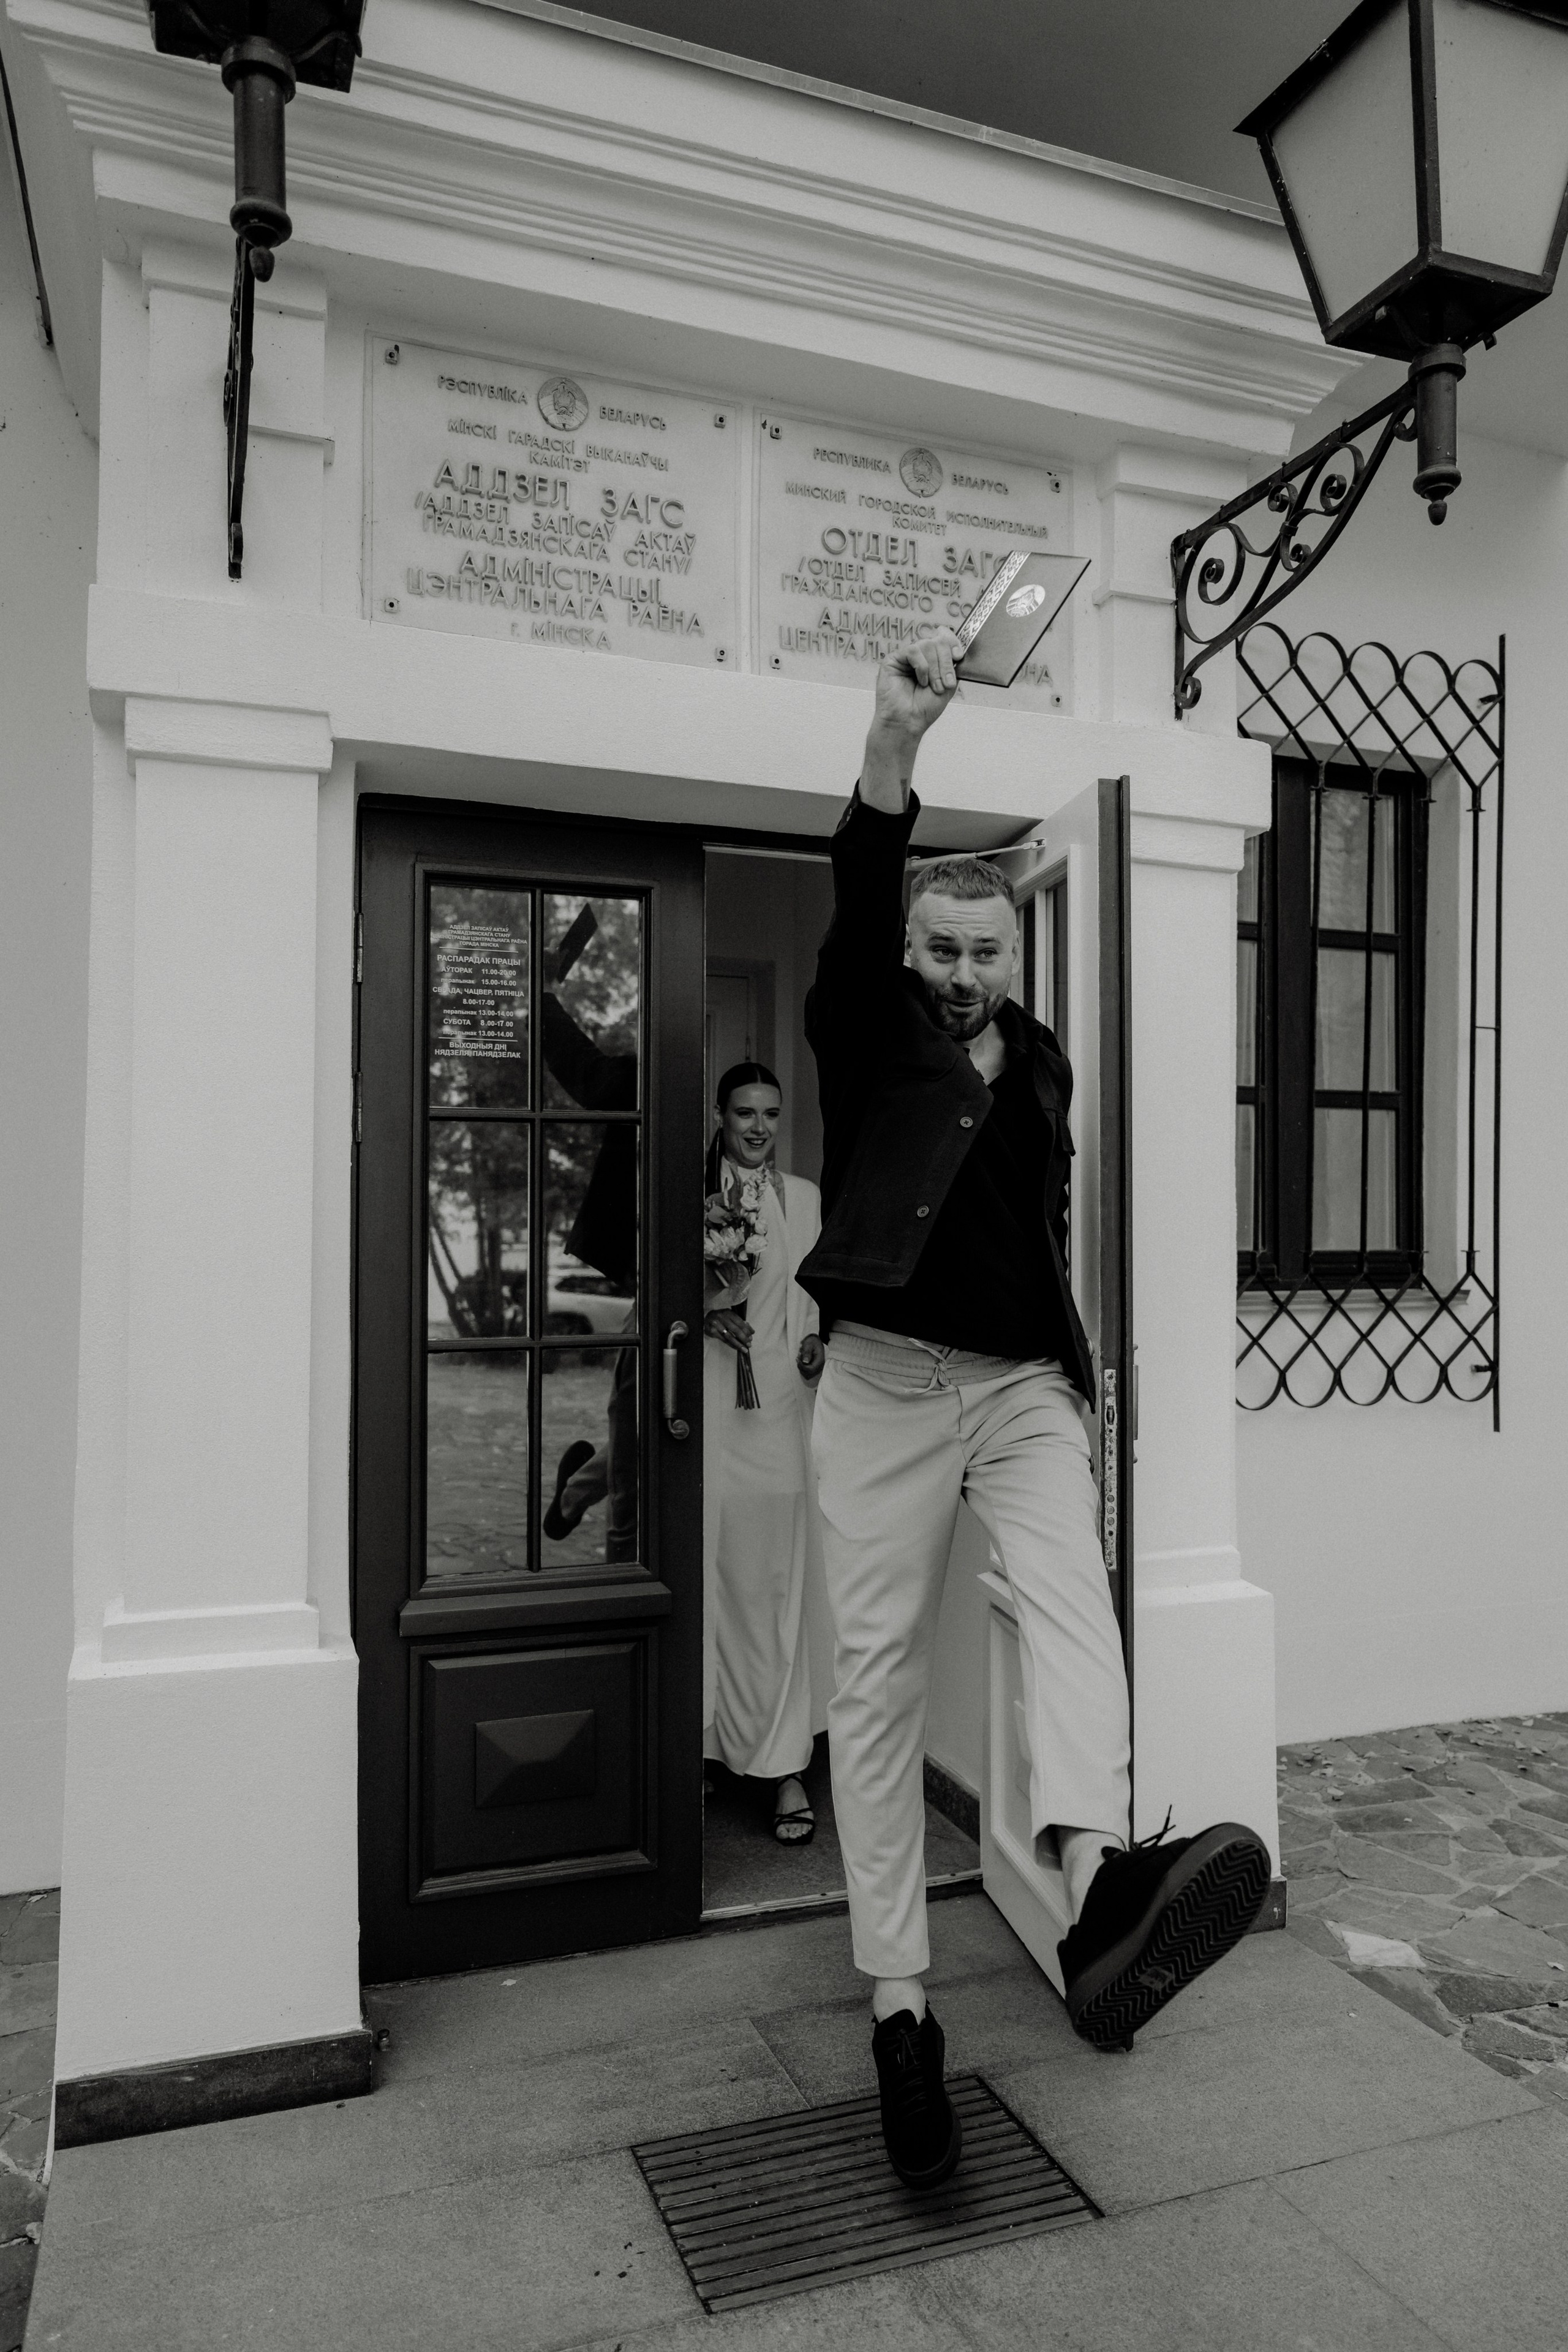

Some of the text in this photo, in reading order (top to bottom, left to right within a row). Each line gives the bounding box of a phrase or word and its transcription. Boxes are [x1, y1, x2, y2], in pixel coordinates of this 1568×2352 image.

[438, 374, 666, 430] РЭСПУБЛІКА БЕЛАРУСЬ
[448, 419, 668, 472] МІНСКІ ГАРАДСКІ ВЫКАНАЎЧЫ
[530, 451, 590, 473] КАМІТЭТ
[813, 447, 1009, 495] РЕСПУБЛИКА БЕЛАРУСЬ
[434, 459, 684, 529] АДДЗЕЛ ЗАГС
[785, 481, 1048, 539] МИНСКИЙ ГОРОДСКОЙ ИСПОЛНИТЕЛЬНЫЙ
[423, 513, 610, 563] ГРАМАДЗЯНСКАГА
[532, 512, 617, 543] ЗАПІСАЎ
[635, 530, 696, 556] АКТАЎ
[821, 526, 918, 567] ОТДЕЛ
[892, 516, 947, 536] КОМИТЕТ
[459, 551, 662, 605] АДМІНІСТРАЦЫІ
[782, 573, 933, 613] ГРАЖДАНСКОГО
[883, 570, 961, 598] ЗАПИСЕЙ
[407, 568, 705, 638] ЦЭНТРАЛЬНАГА РАЁНА
[532, 620, 611, 650] МІНСКА
[437, 954, 490, 965] РАСПАРАДАК
[442, 965, 473, 974] АЎТОРАК
